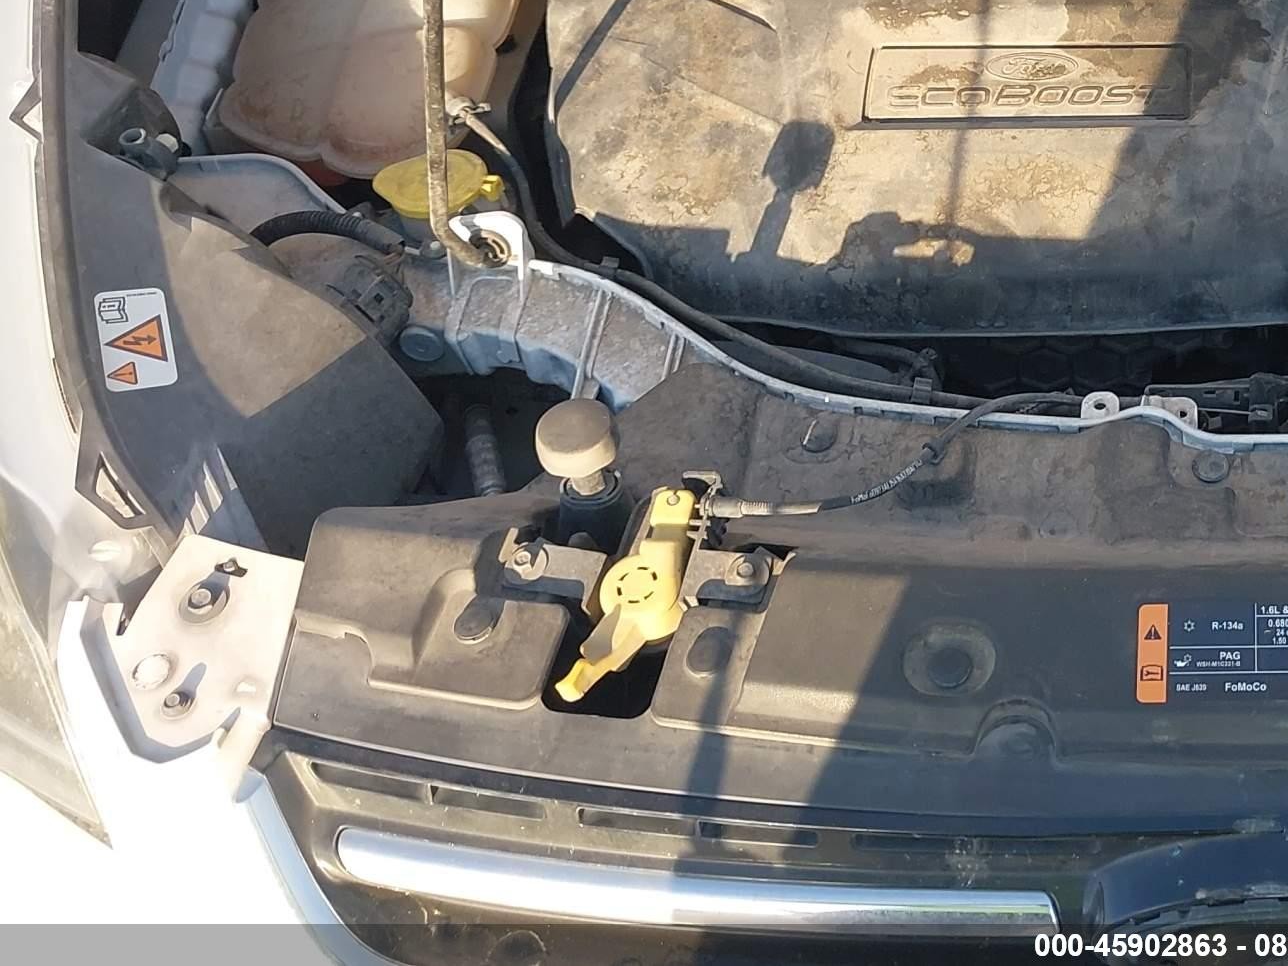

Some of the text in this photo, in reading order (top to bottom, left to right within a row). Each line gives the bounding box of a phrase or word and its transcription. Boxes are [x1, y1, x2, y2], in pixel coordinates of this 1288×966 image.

[1261, 606, 1280, 614] 1.6L
[1211, 621, 1243, 630] R-134a
[1219, 651, 1241, 660] PAG
[1224, 682, 1267, 692] FoMoCo
